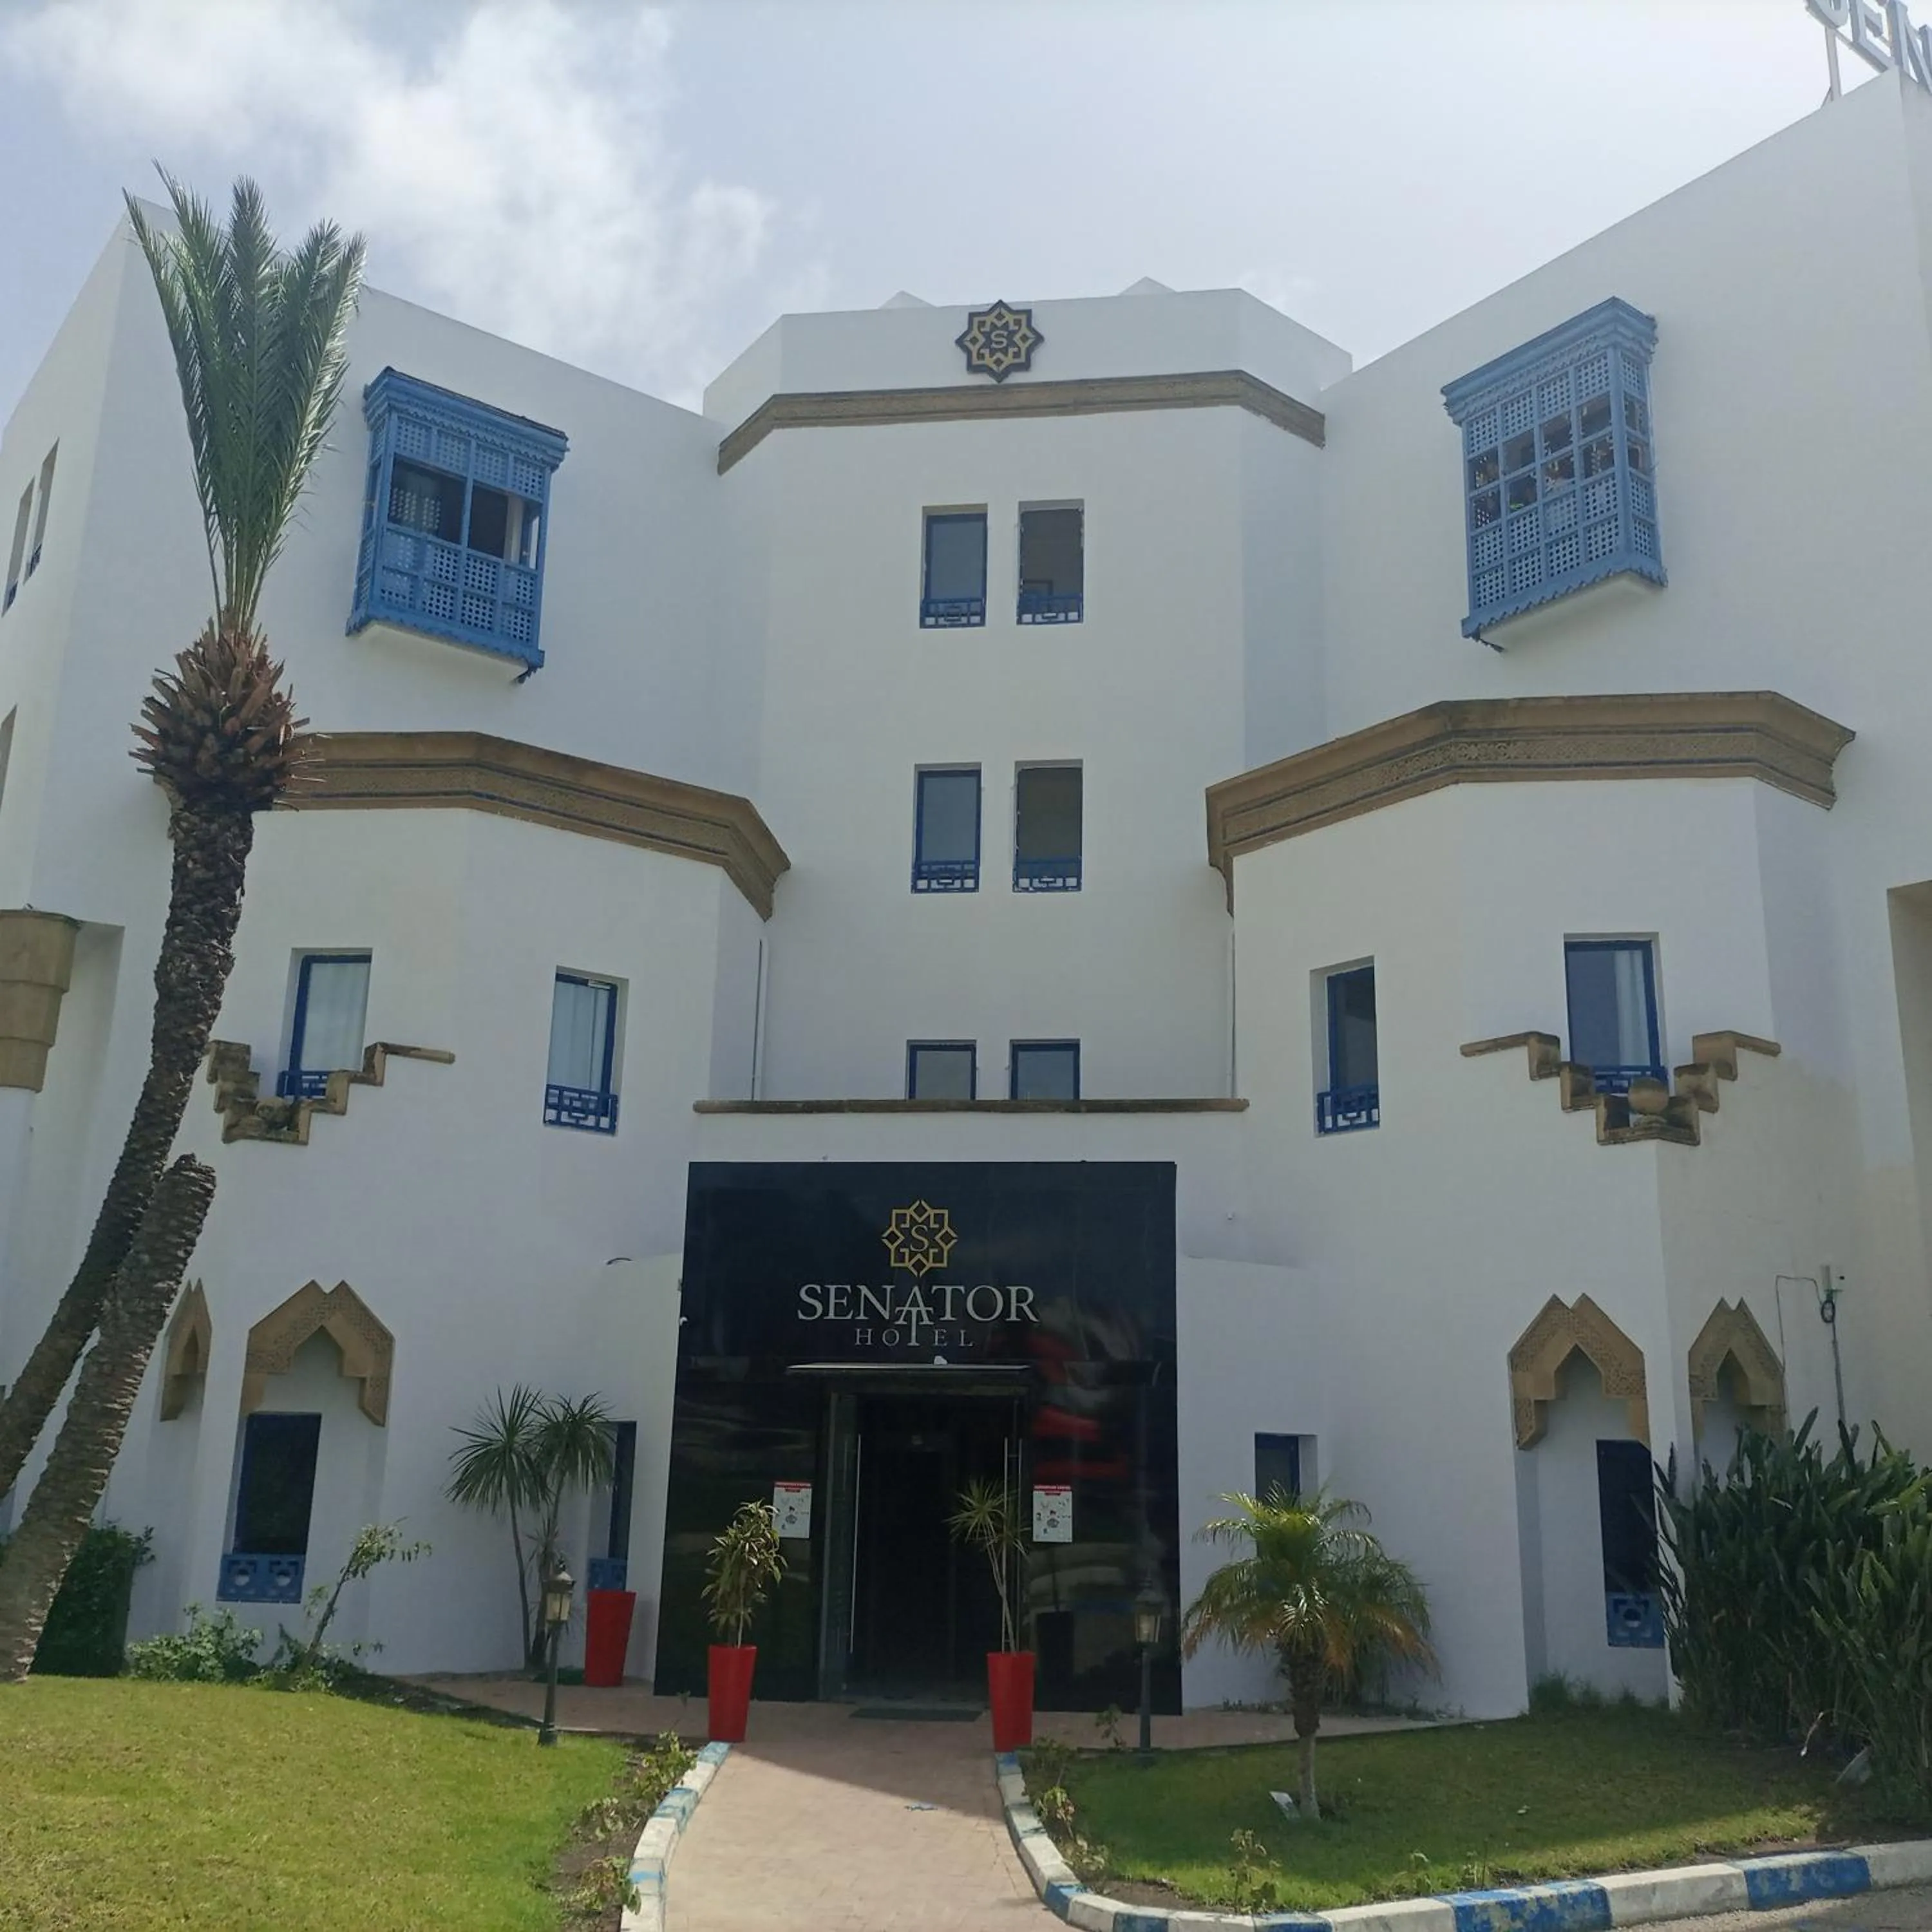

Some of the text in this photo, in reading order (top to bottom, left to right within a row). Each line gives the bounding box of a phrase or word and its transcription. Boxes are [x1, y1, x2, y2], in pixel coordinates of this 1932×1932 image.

[990, 330, 1008, 348] S
[909, 1224, 929, 1252] S
[797, 1284, 1040, 1325] SENATOR
[855, 1307, 974, 1347] HOTEL
